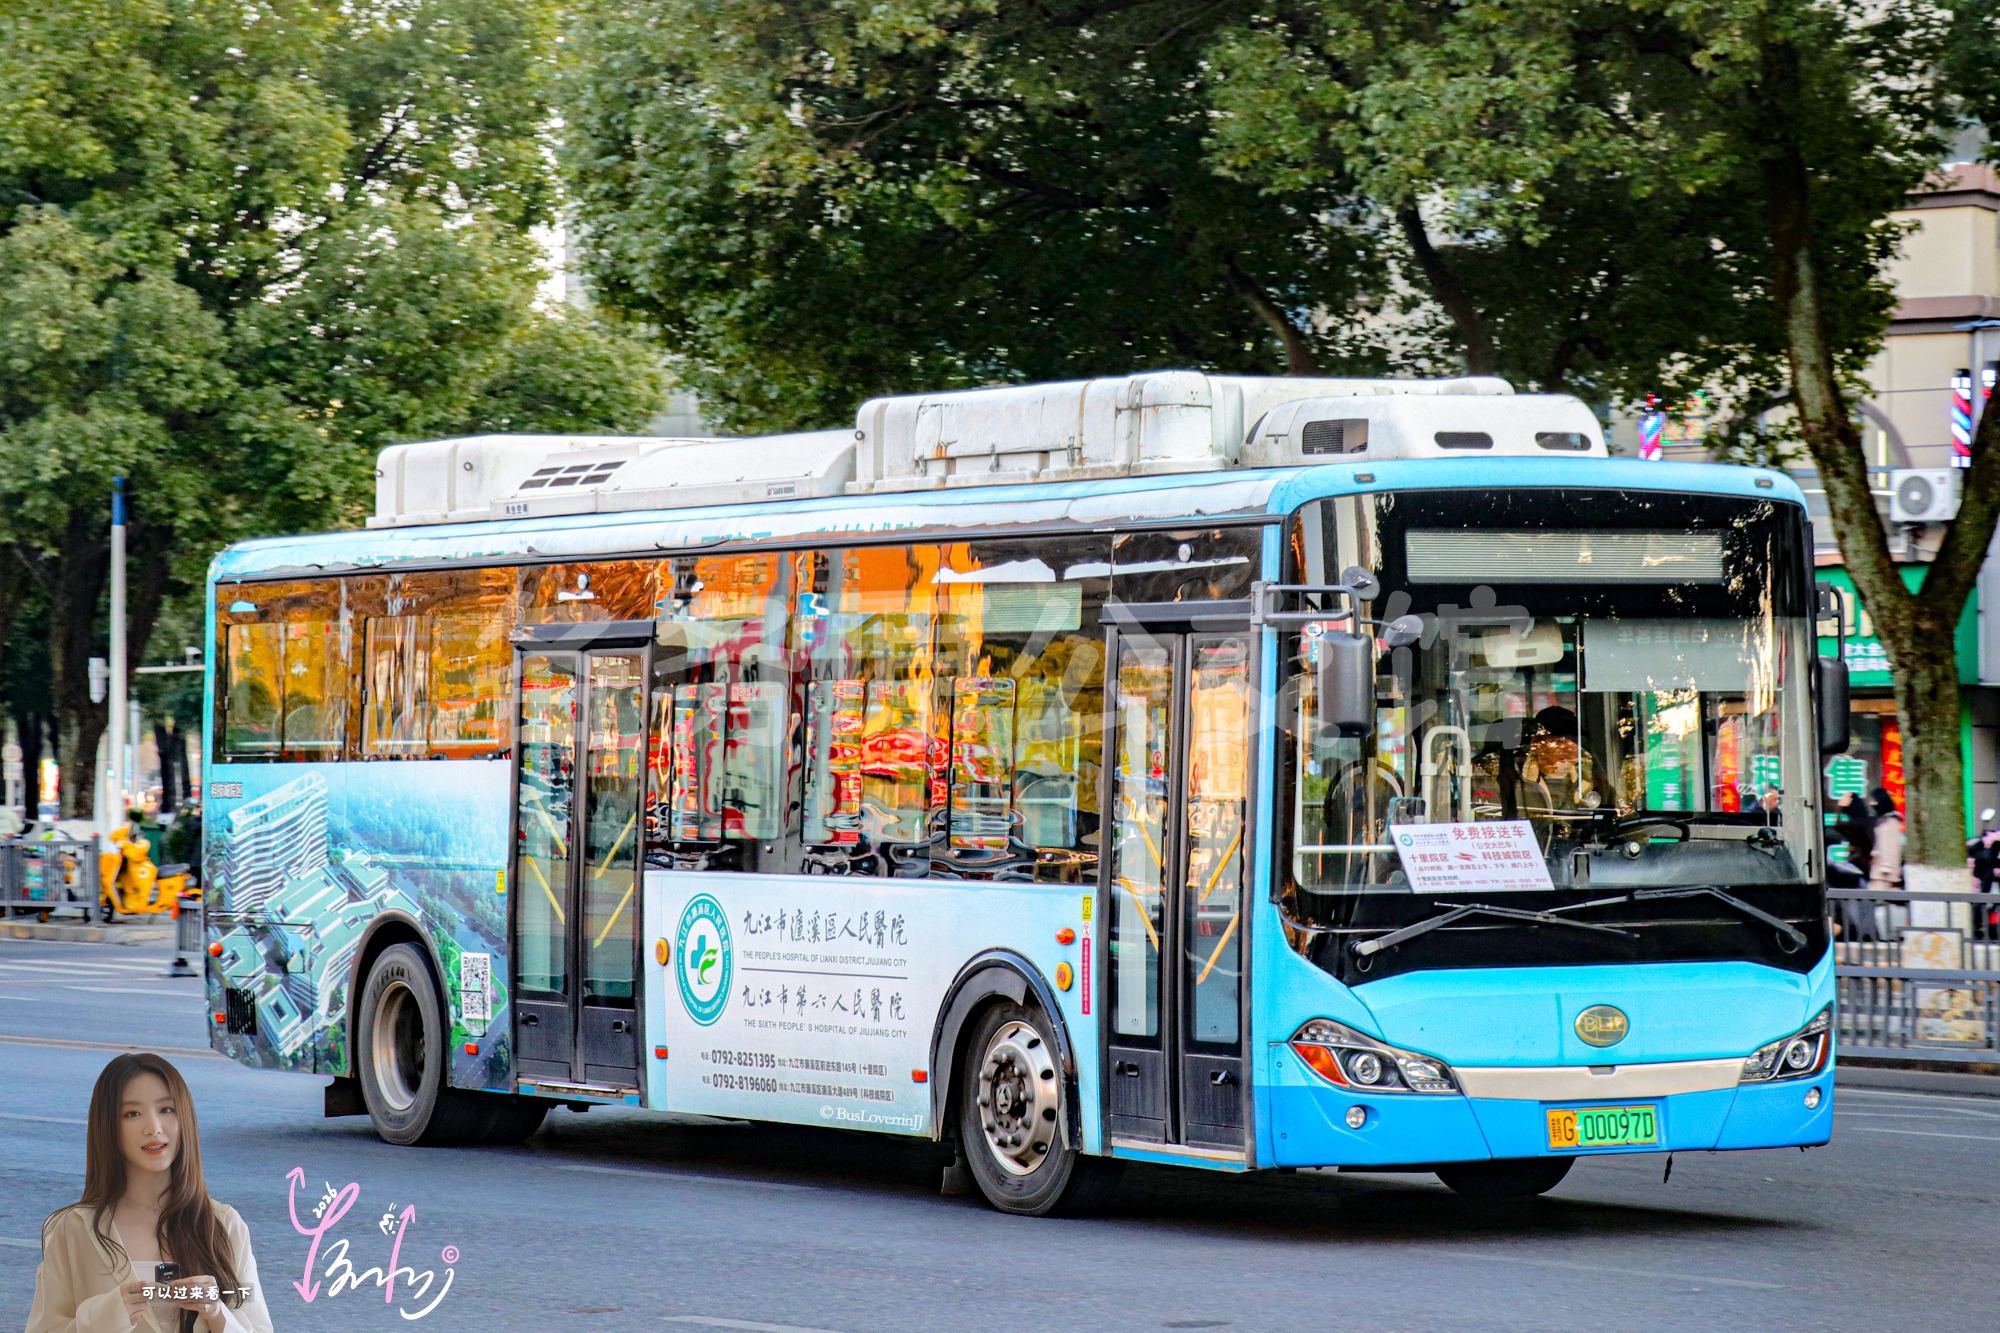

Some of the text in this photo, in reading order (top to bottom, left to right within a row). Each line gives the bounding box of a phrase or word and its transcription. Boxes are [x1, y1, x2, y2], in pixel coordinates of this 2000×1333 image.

[1452, 825, 1526, 841] 免费接送车
[1409, 853, 1450, 863] 十里院区
[743, 950, 754, 959] THE
[754, 951, 782, 960] PEOPLE'S
[782, 953, 810, 963] HOSPITAL
[811, 954, 819, 963] OF
[819, 955, 838, 964] LIANXI
[893, 958, 908, 967] CITY
[744, 1019, 757, 1028] THE
[758, 1020, 777, 1029] SIXTH
[814, 1025, 847, 1035] HOSPITAL
[848, 1026, 857, 1035] OF
[859, 1027, 890, 1038] JIUJIANG
[891, 1029, 908, 1039] CITY
